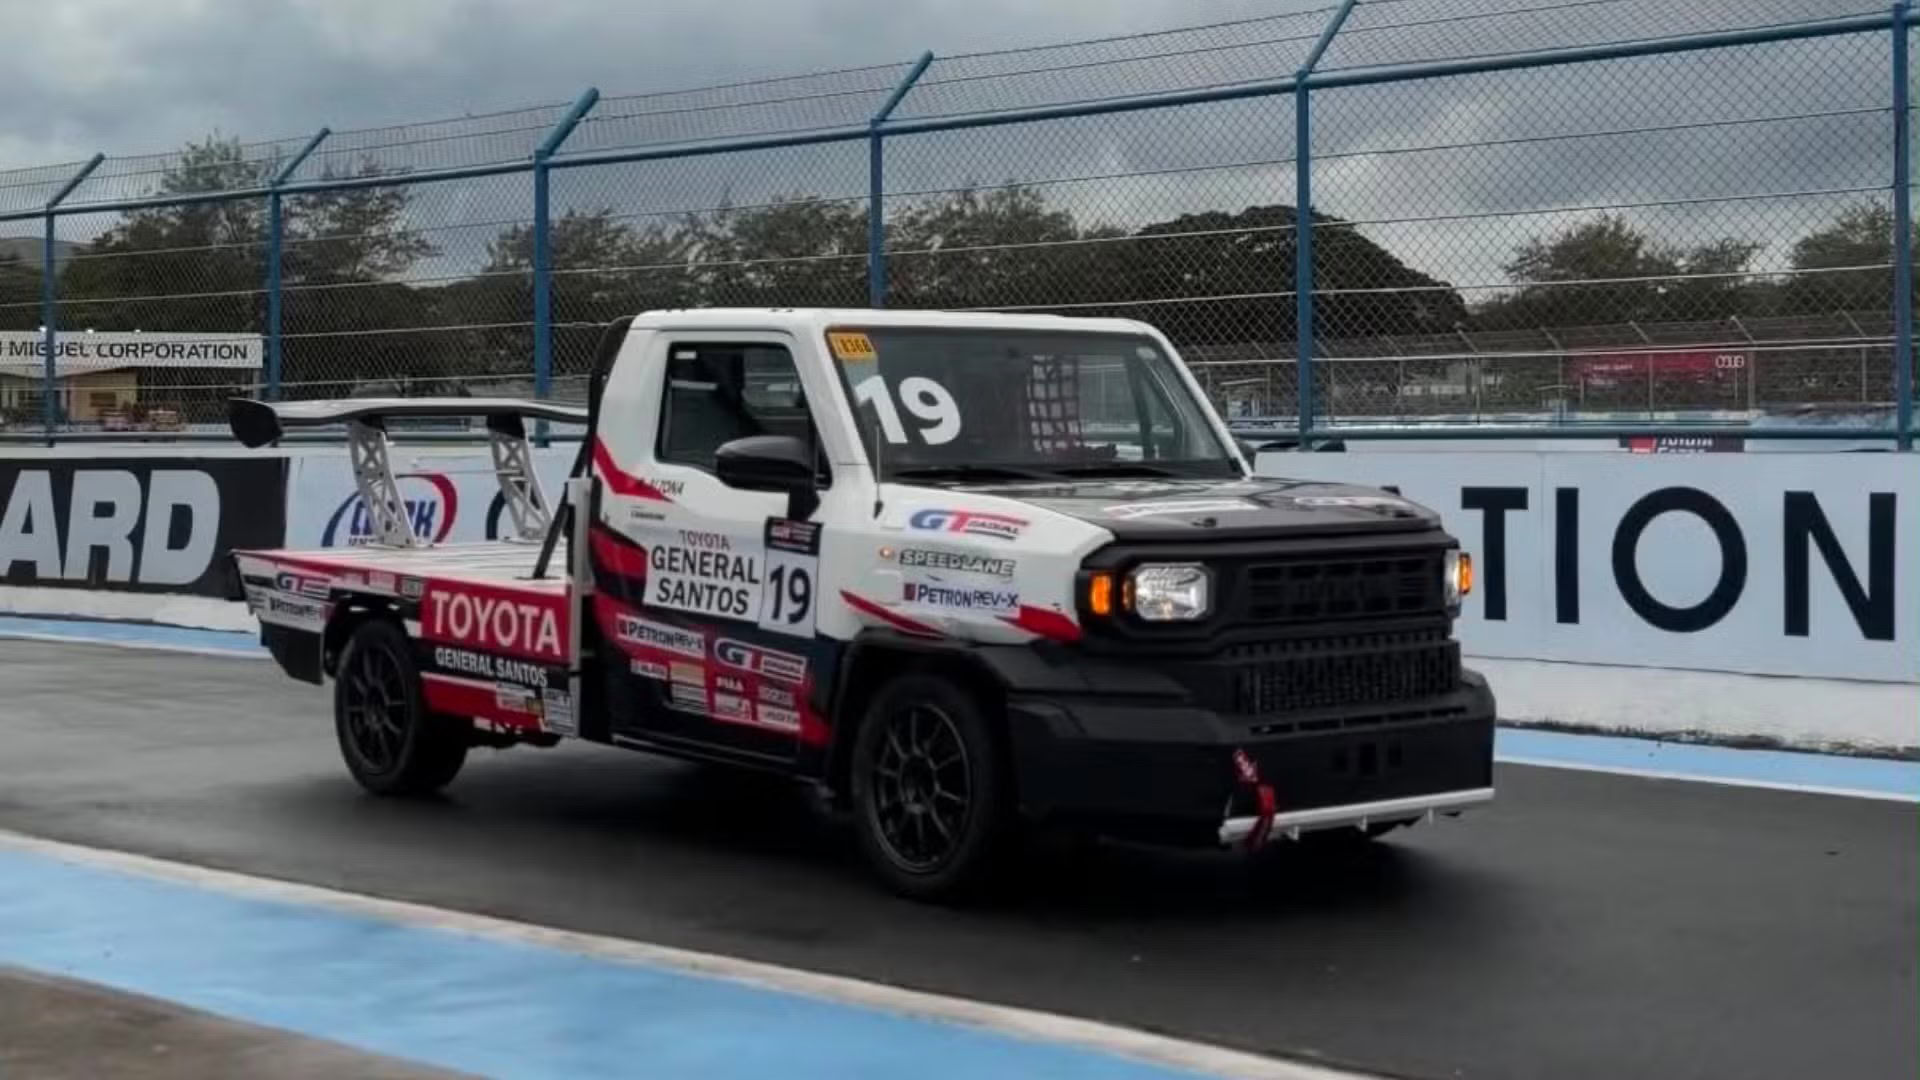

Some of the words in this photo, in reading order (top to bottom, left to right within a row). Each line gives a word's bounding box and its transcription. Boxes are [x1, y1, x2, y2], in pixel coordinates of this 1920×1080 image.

[9, 341, 90, 358] MIGUEL
[96, 342, 248, 360] CORPORATION
[854, 374, 961, 446] 19
[0, 469, 221, 586] ARD
[679, 530, 730, 550] TOYOTA
[652, 545, 760, 585] GENERAL
[899, 549, 1017, 577] SPEEDLANE
[1461, 486, 1897, 641] TION
[657, 578, 749, 615] SANTOS
[769, 564, 811, 625] 19
[431, 590, 561, 656] TOYOTA
[435, 648, 495, 677] GENERAL
[496, 662, 548, 688] SANTOS
